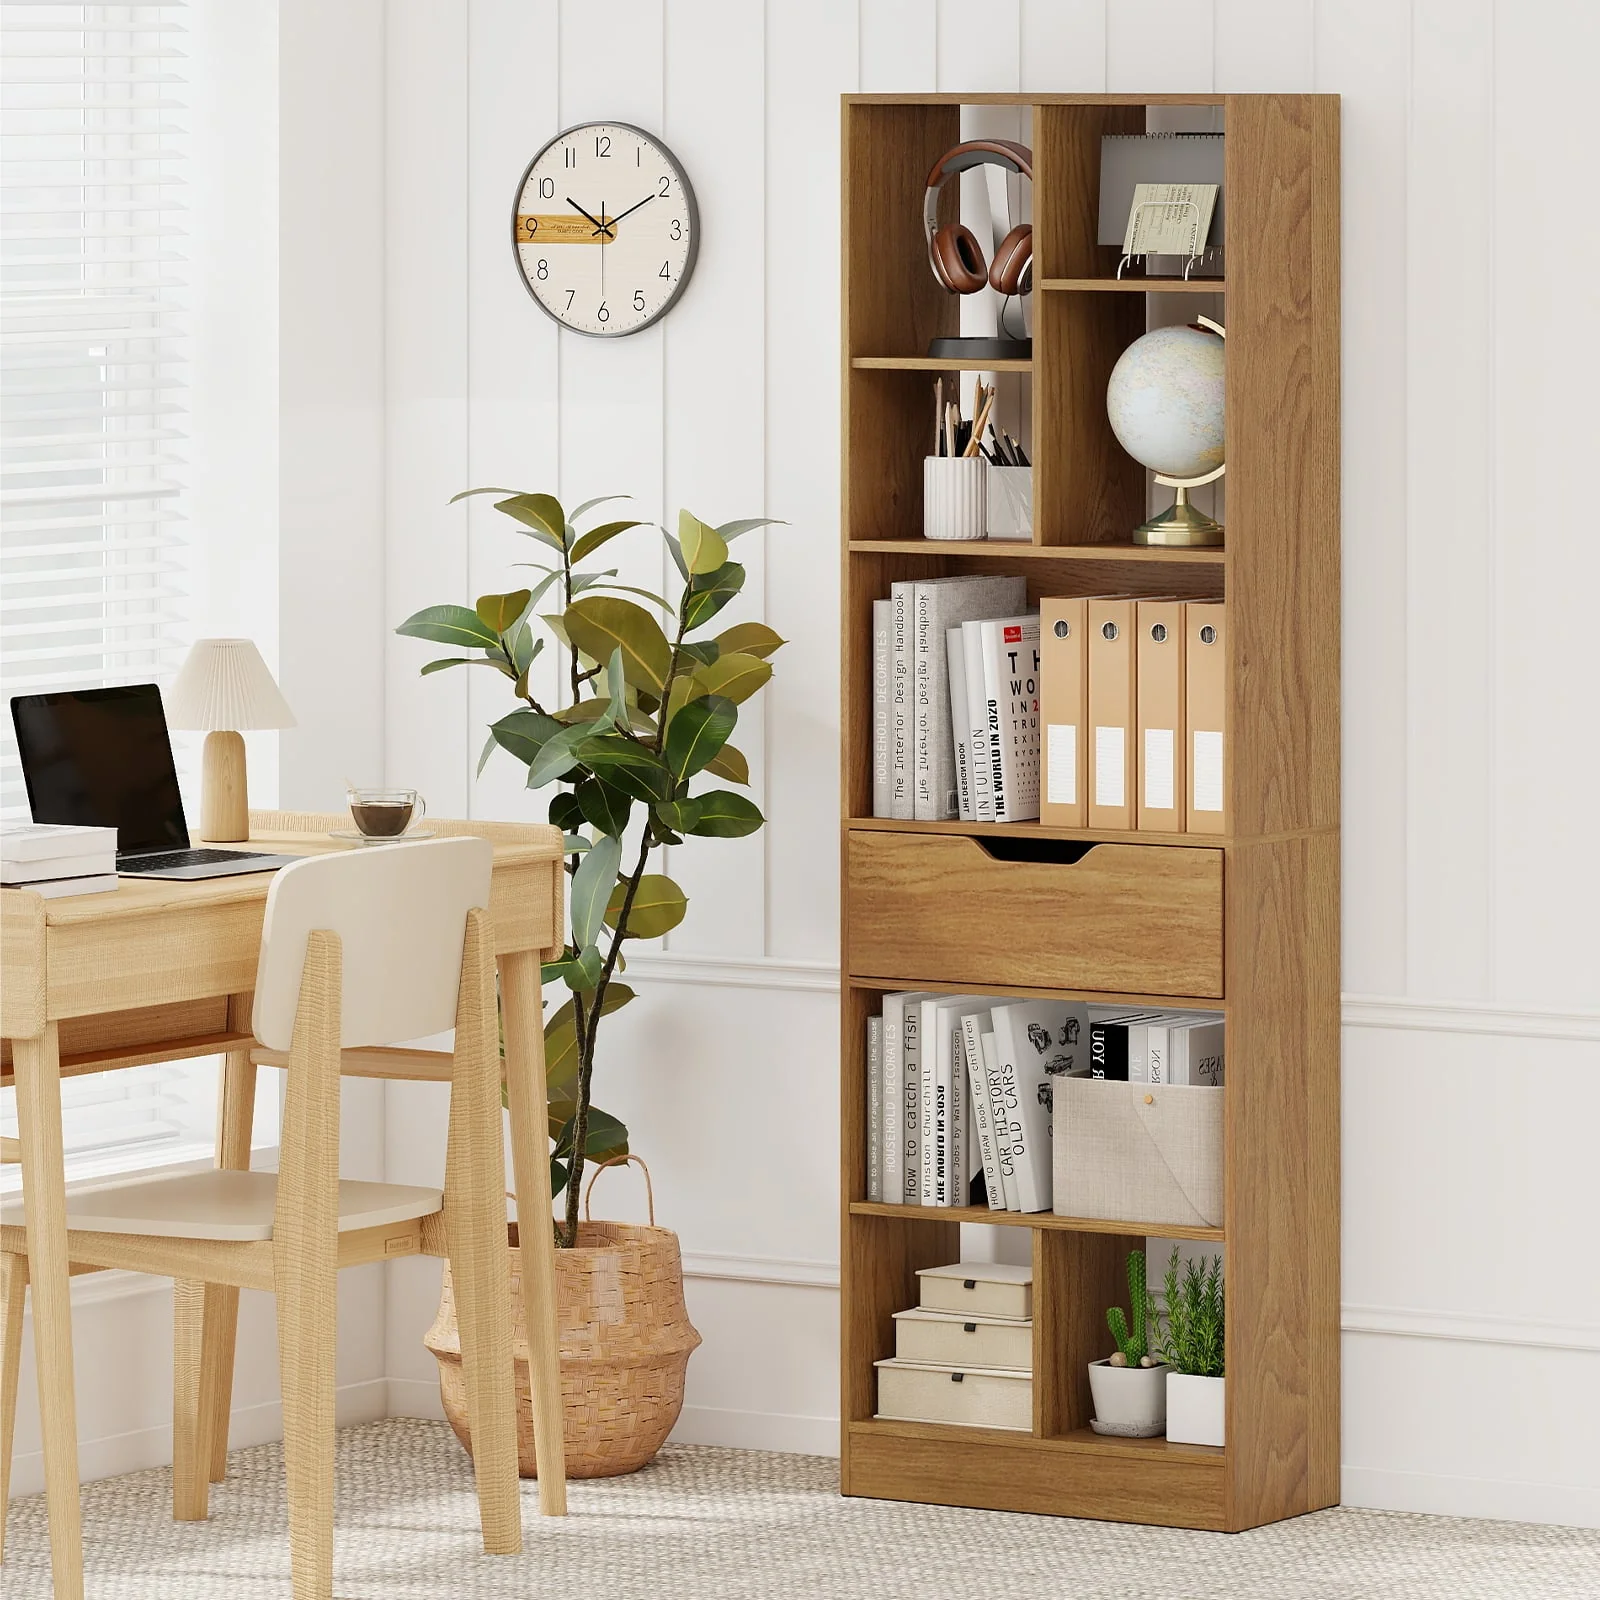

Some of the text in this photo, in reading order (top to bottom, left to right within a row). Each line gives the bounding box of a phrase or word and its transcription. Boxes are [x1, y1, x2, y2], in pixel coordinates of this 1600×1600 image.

[565, 147, 576, 168] 11
[596, 136, 611, 158] 12
[539, 178, 554, 198] 10
[658, 176, 670, 198] 2
[526, 218, 538, 239] 9
[670, 220, 682, 240] 3
[537, 259, 548, 280] 8
[658, 260, 670, 281] 4
[566, 290, 575, 310] 7
[633, 290, 646, 312] 5
[598, 301, 610, 322] 6
[894, 592, 907, 800] The Interior Design Handbook
[876, 630, 887, 784] HOUSEHOLD DECORATES
[1011, 700, 1027, 714] IN
[987, 699, 1006, 817] THE WORLD IN 2020
[972, 728, 990, 816] INTUITION
[871, 1066, 877, 1075] in
[885, 1024, 896, 1172] HOUSEHOLD DECORATES
[904, 1015, 917, 1197] How to catch a fish
[966, 1020, 999, 1205] HOW TO DRAW Book for children
[1001, 1064, 1025, 1156] OLD CARS
[987, 1067, 1014, 1176] CAR HISTORY
[871, 1132, 877, 1142] an
[923, 1069, 931, 1197] Winston Churchill
[953, 1127, 962, 1138] by
[871, 1168, 877, 1177] to
